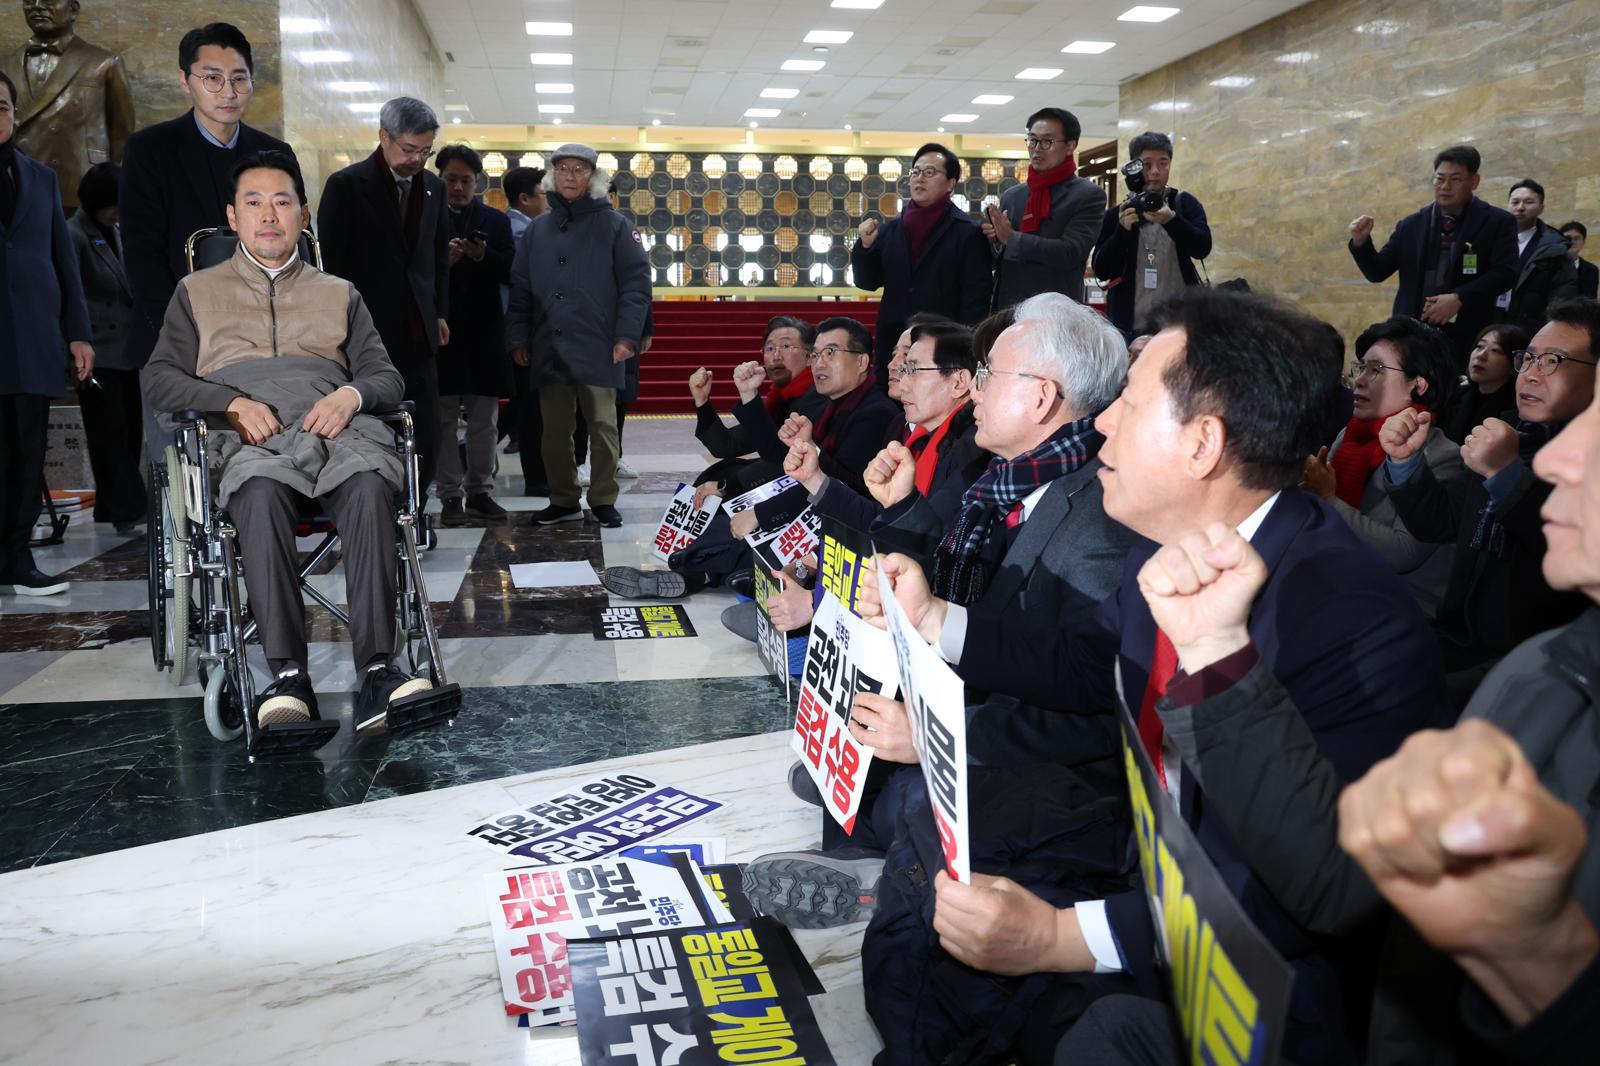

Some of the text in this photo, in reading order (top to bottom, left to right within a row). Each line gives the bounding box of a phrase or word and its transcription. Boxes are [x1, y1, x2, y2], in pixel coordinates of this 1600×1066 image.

[654, 524, 678, 555] 특검
[665, 499, 710, 538] 공천 뇌물
[778, 521, 808, 557] 특검
[822, 535, 857, 611] 통일교
[601, 608, 645, 638] 특검 수용
[770, 628, 785, 685] 수용
[806, 624, 840, 706] 공천
[796, 686, 860, 815] 특검 수용
[466, 775, 657, 847] 야당 탄압 중단
[530, 794, 710, 864] 무도한 여당
[499, 870, 574, 930] 특검
[566, 863, 647, 919] 공천
[649, 896, 683, 926] 민주당
[510, 931, 573, 1003] 수용
[596, 936, 689, 1017] 특검
[681, 928, 779, 1007] 통일교
[609, 1023, 699, 1066] 수
